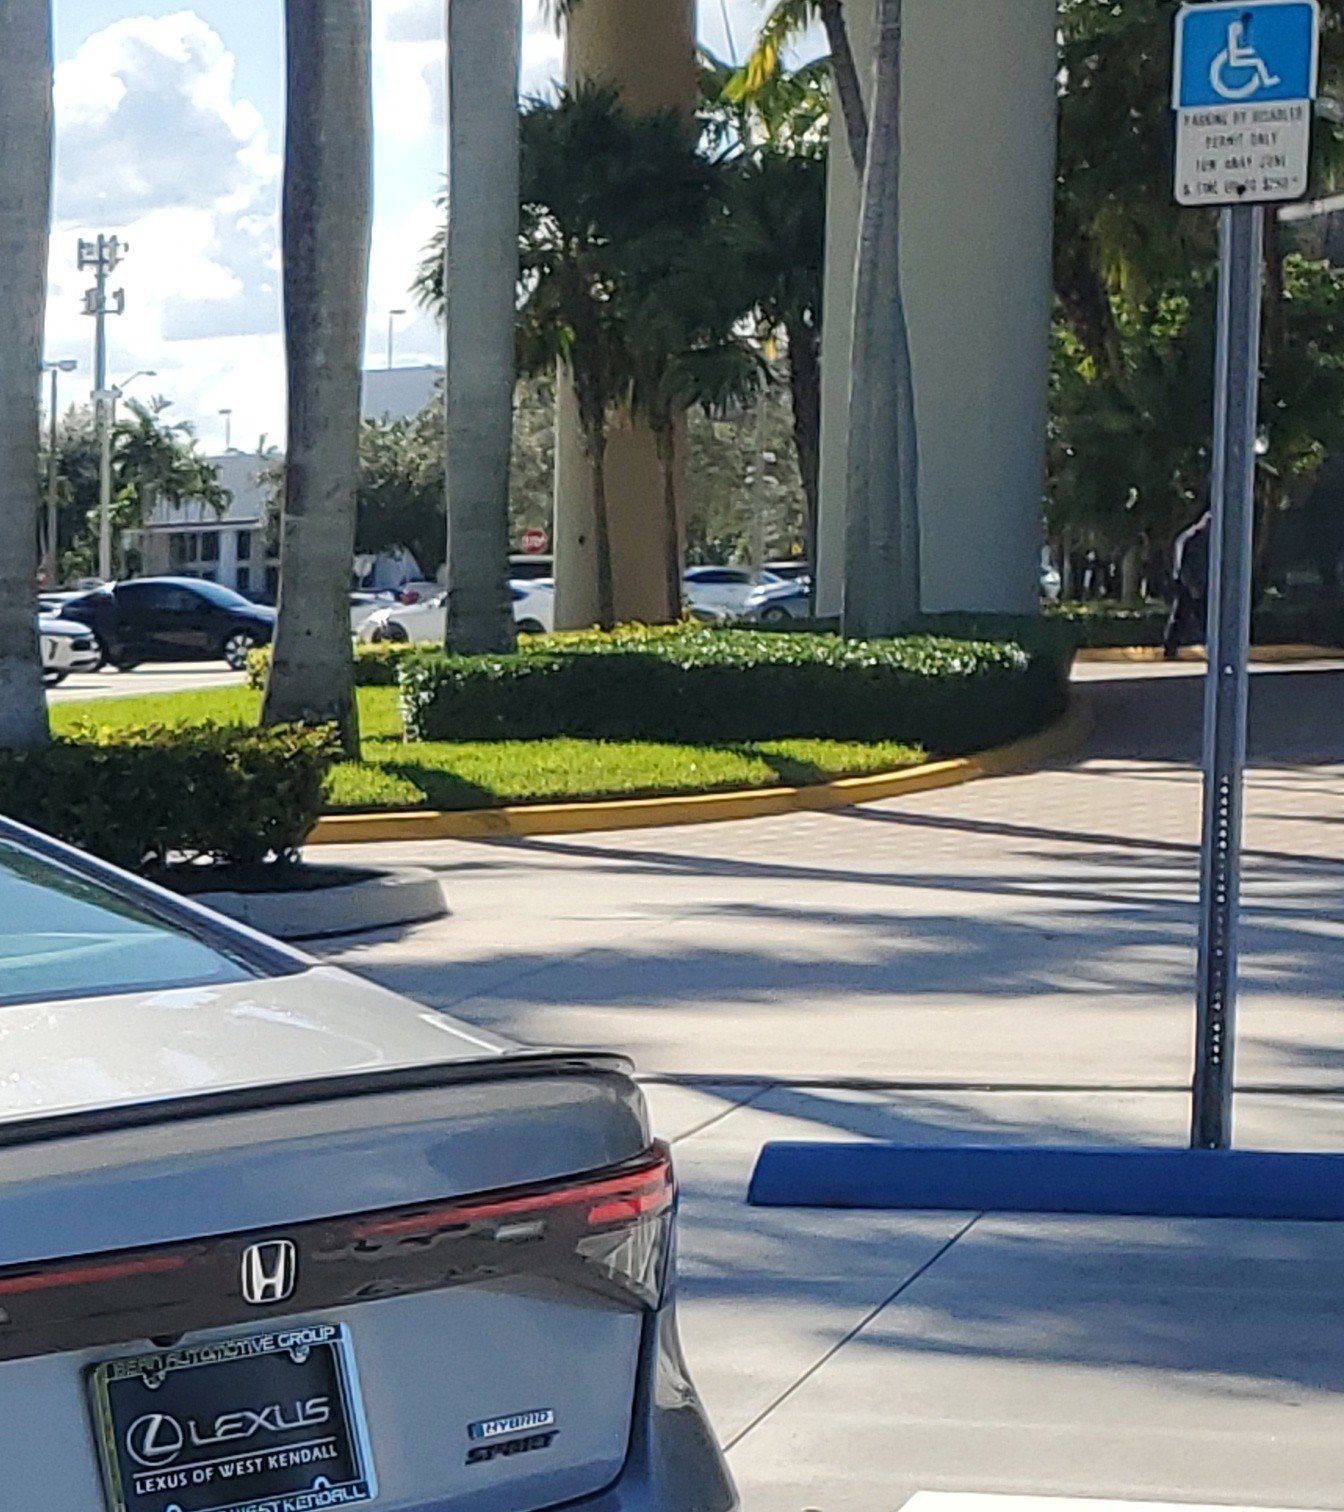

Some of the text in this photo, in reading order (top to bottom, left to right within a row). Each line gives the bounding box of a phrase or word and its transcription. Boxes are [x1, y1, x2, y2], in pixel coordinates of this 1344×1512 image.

[277, 1326, 336, 1348] GROUP
[187, 1396, 332, 1446] LEXUS
[465, 1429, 561, 1466] SPORT
[135, 1444, 338, 1495] LEXUS OF WEST KENDALL
